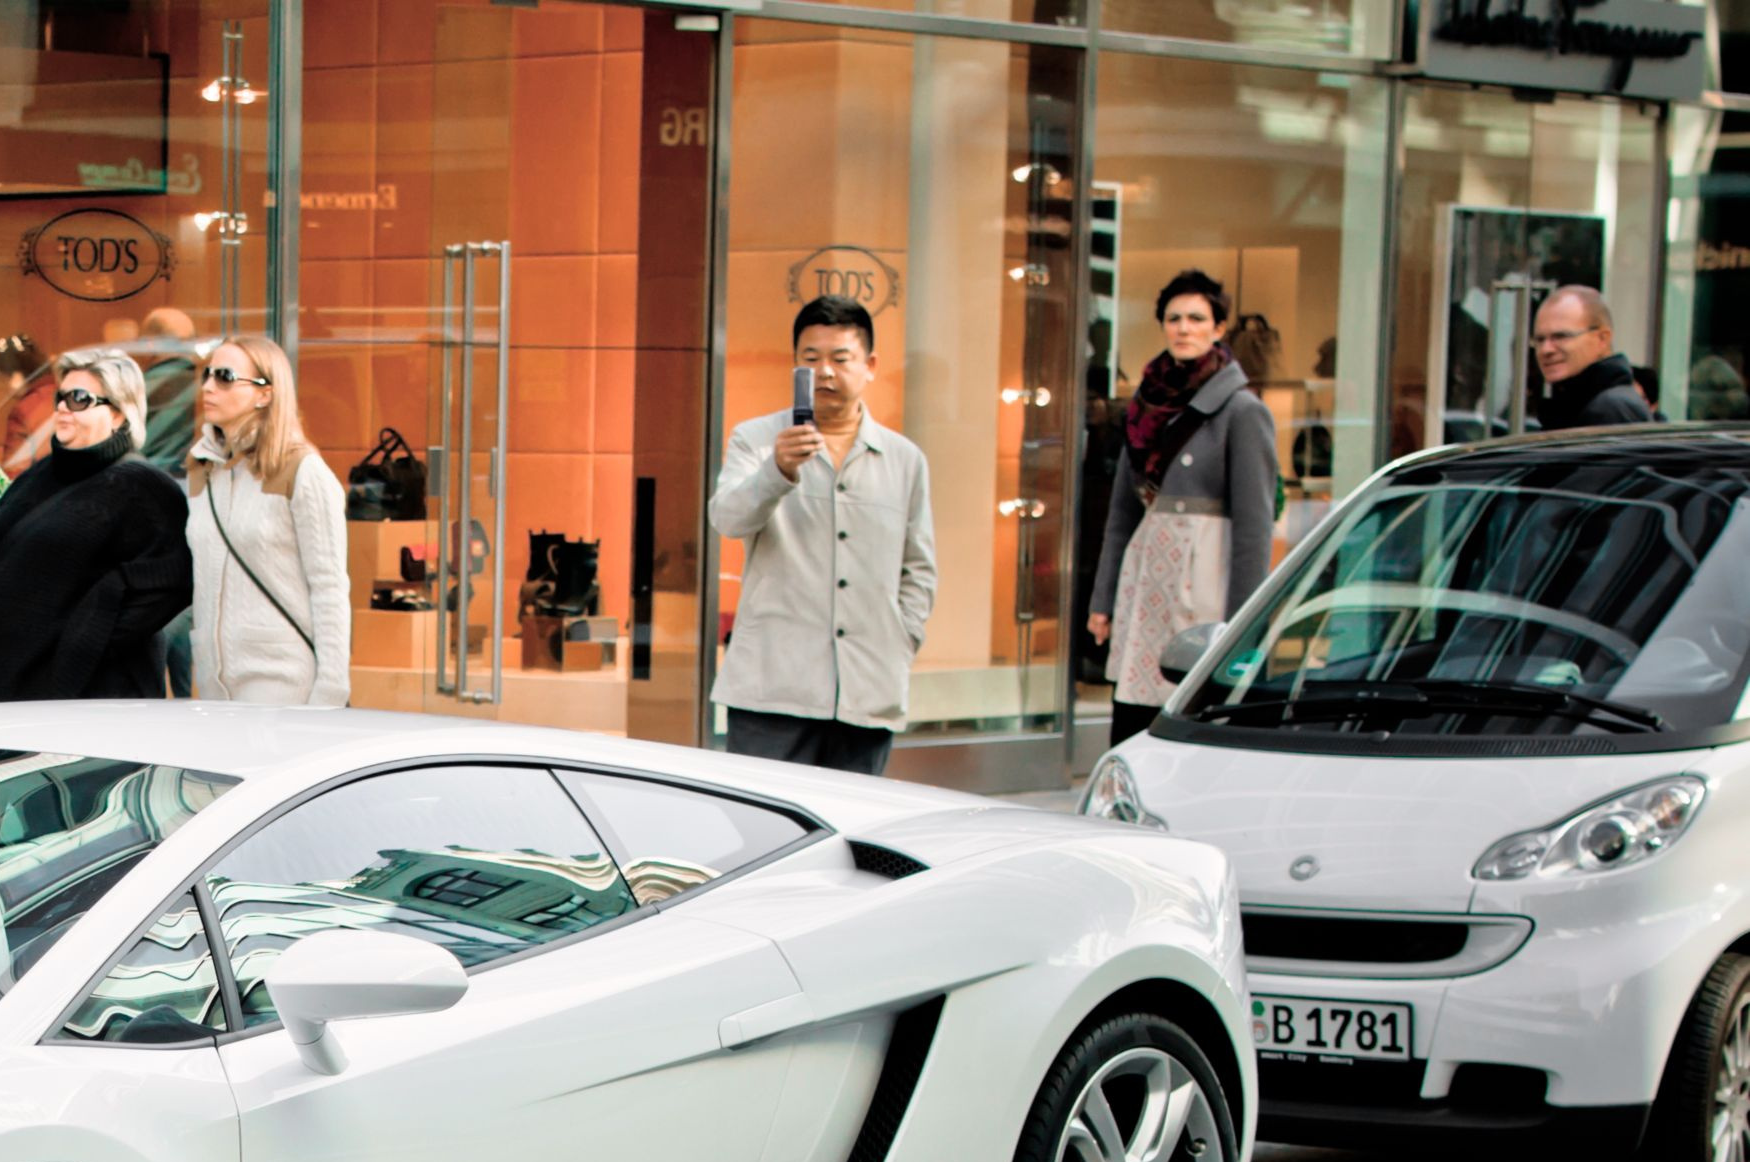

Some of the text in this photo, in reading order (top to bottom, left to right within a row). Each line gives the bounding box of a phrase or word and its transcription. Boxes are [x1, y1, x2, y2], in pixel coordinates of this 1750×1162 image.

[57, 236, 139, 274] TOD'S
[1272, 1005, 1404, 1053] B 1781
